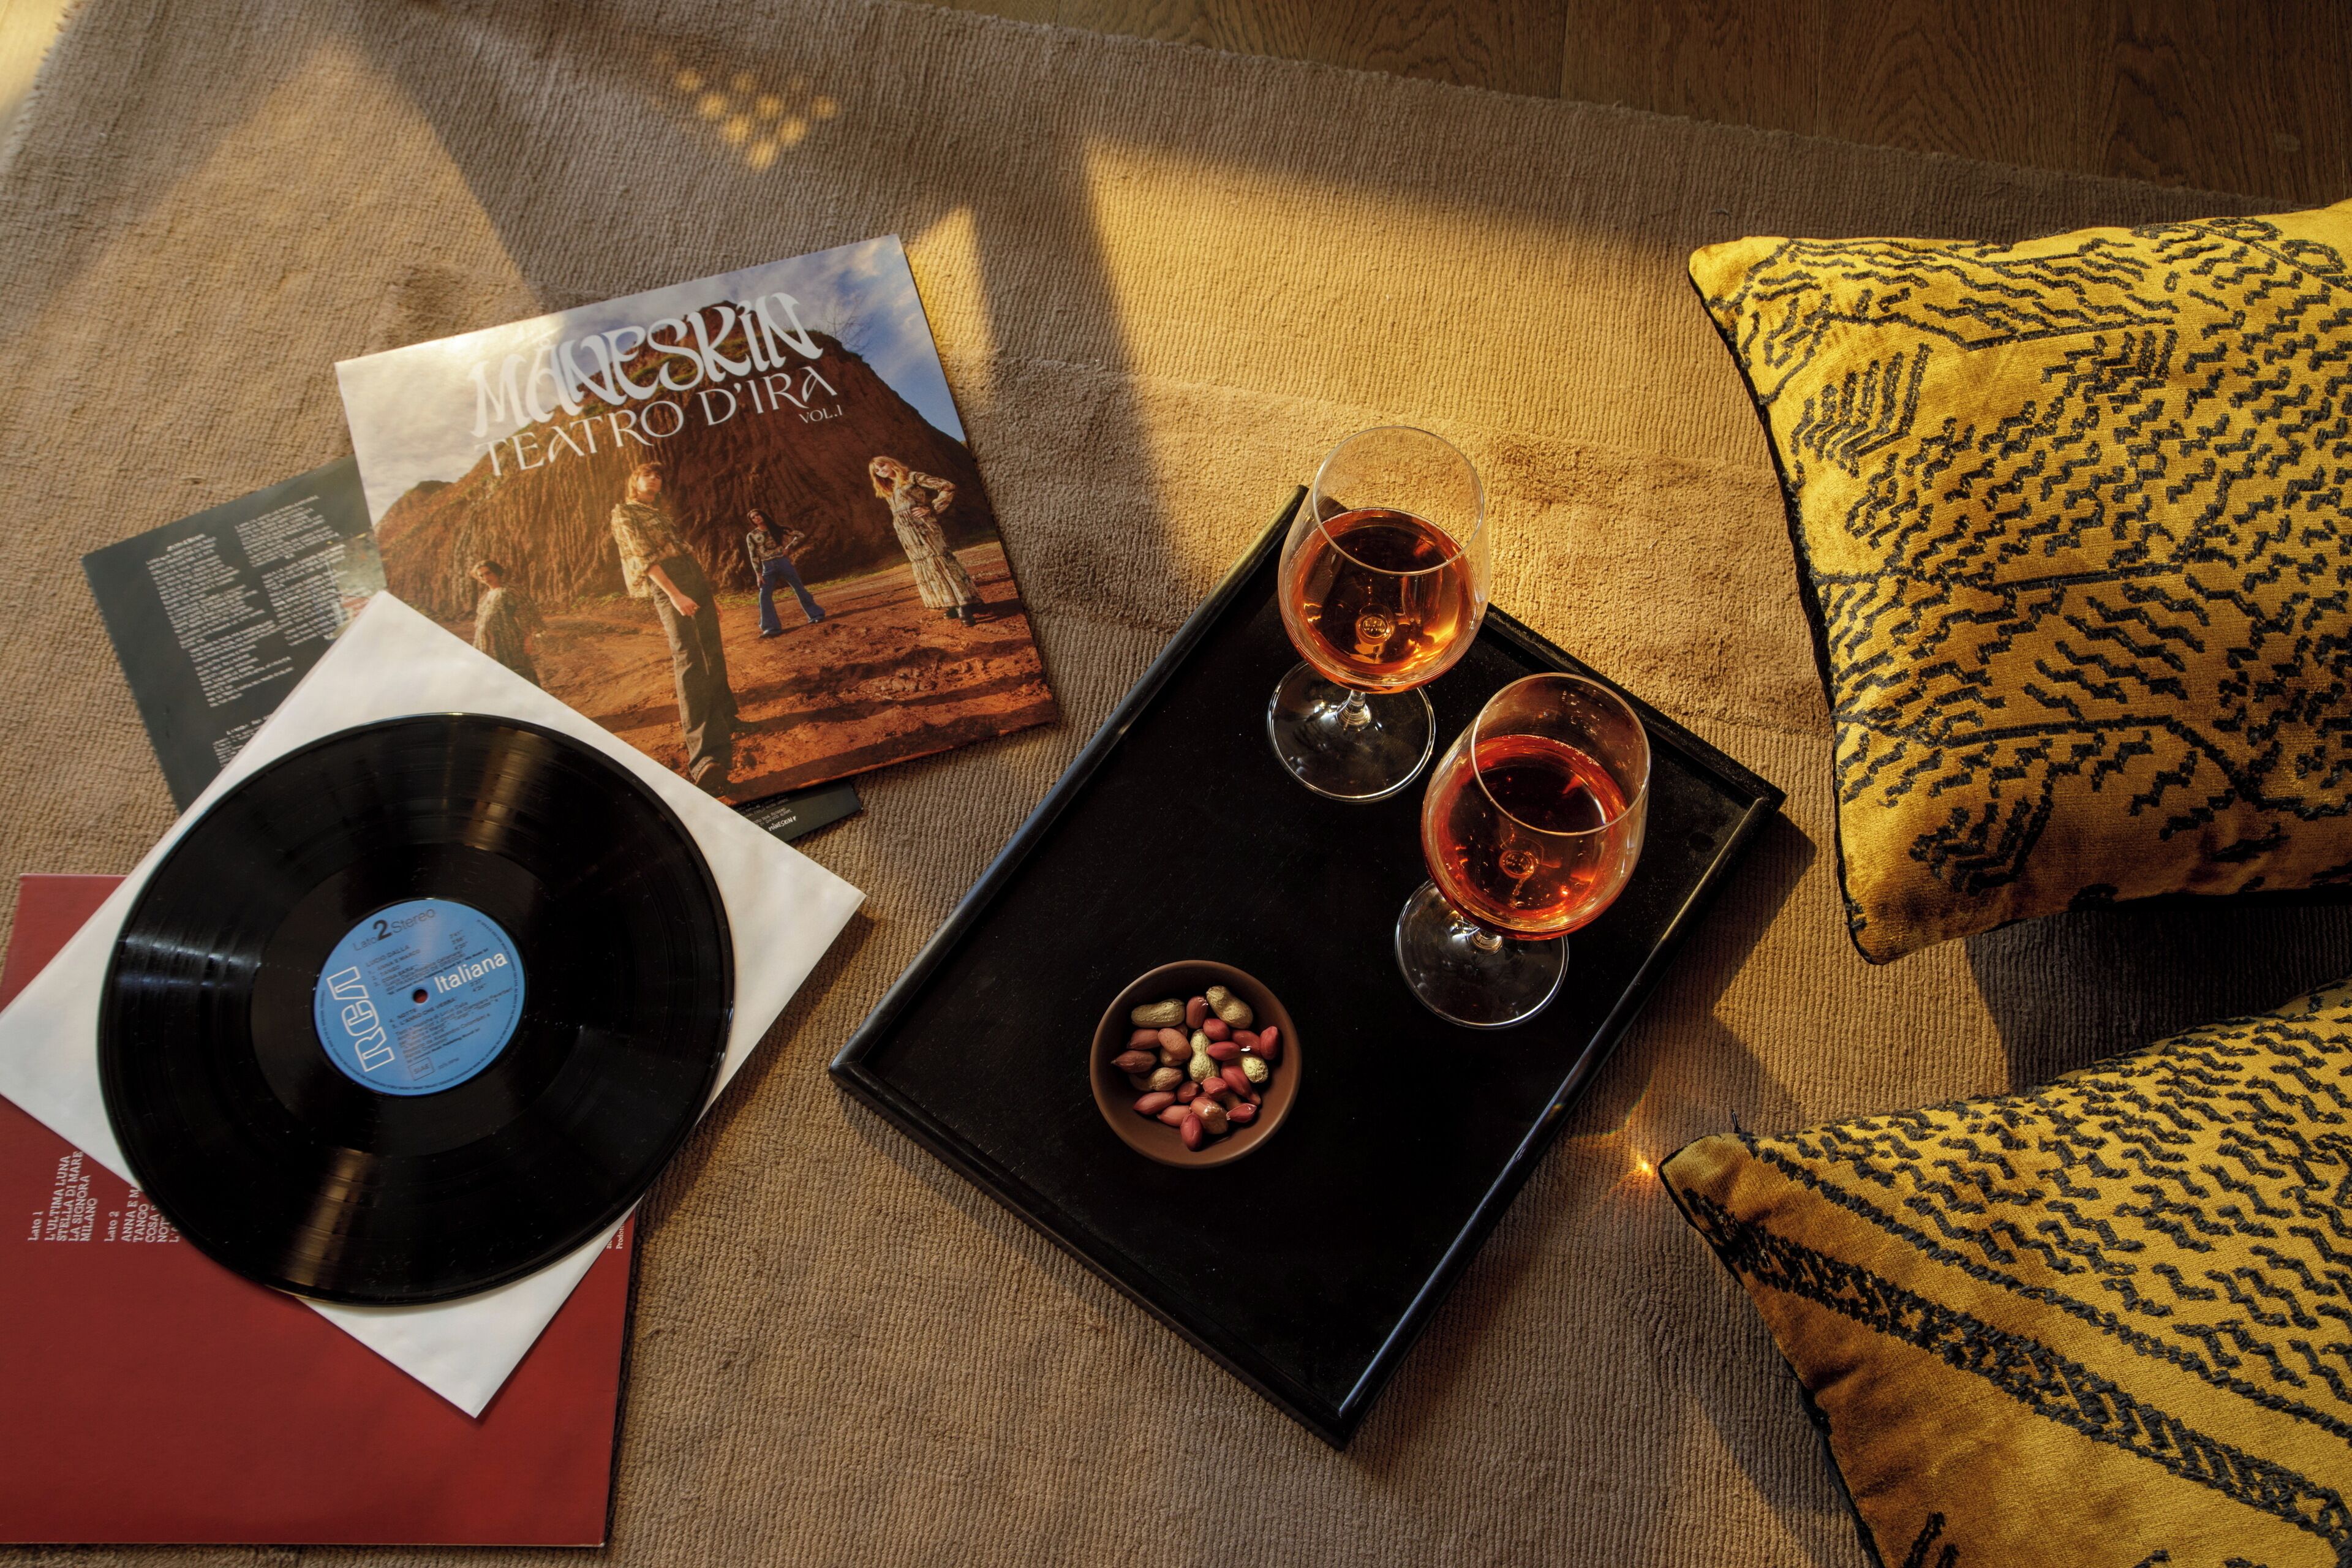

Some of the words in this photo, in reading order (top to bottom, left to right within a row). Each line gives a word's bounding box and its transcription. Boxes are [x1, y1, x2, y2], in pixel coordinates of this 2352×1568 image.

[475, 401, 684, 477] TEATRO
[699, 366, 837, 426] D'IRA
[353, 937, 377, 951] Lato
[372, 919, 393, 941] 2
[391, 909, 437, 933] Stereo
[386, 945, 410, 958] DALLA
[434, 953, 508, 993] Italiana
[67, 1151, 84, 1182] MARE
[44, 1188, 65, 1241] L'ULTIMA
[55, 1155, 71, 1186] LUNA
[64, 1185, 78, 1197] DI
[72, 1175, 91, 1224] SIGNORA
[28, 1218, 42, 1241] Lato
[56, 1200, 75, 1242] STELLA
[68, 1227, 81, 1242] LA
[80, 1197, 98, 1242] MILANO
[104, 1219, 118, 1242] Lato
[121, 1210, 137, 1242] ANNA
[132, 1204, 150, 1242] TANGO
[145, 1213, 160, 1243] COSA
